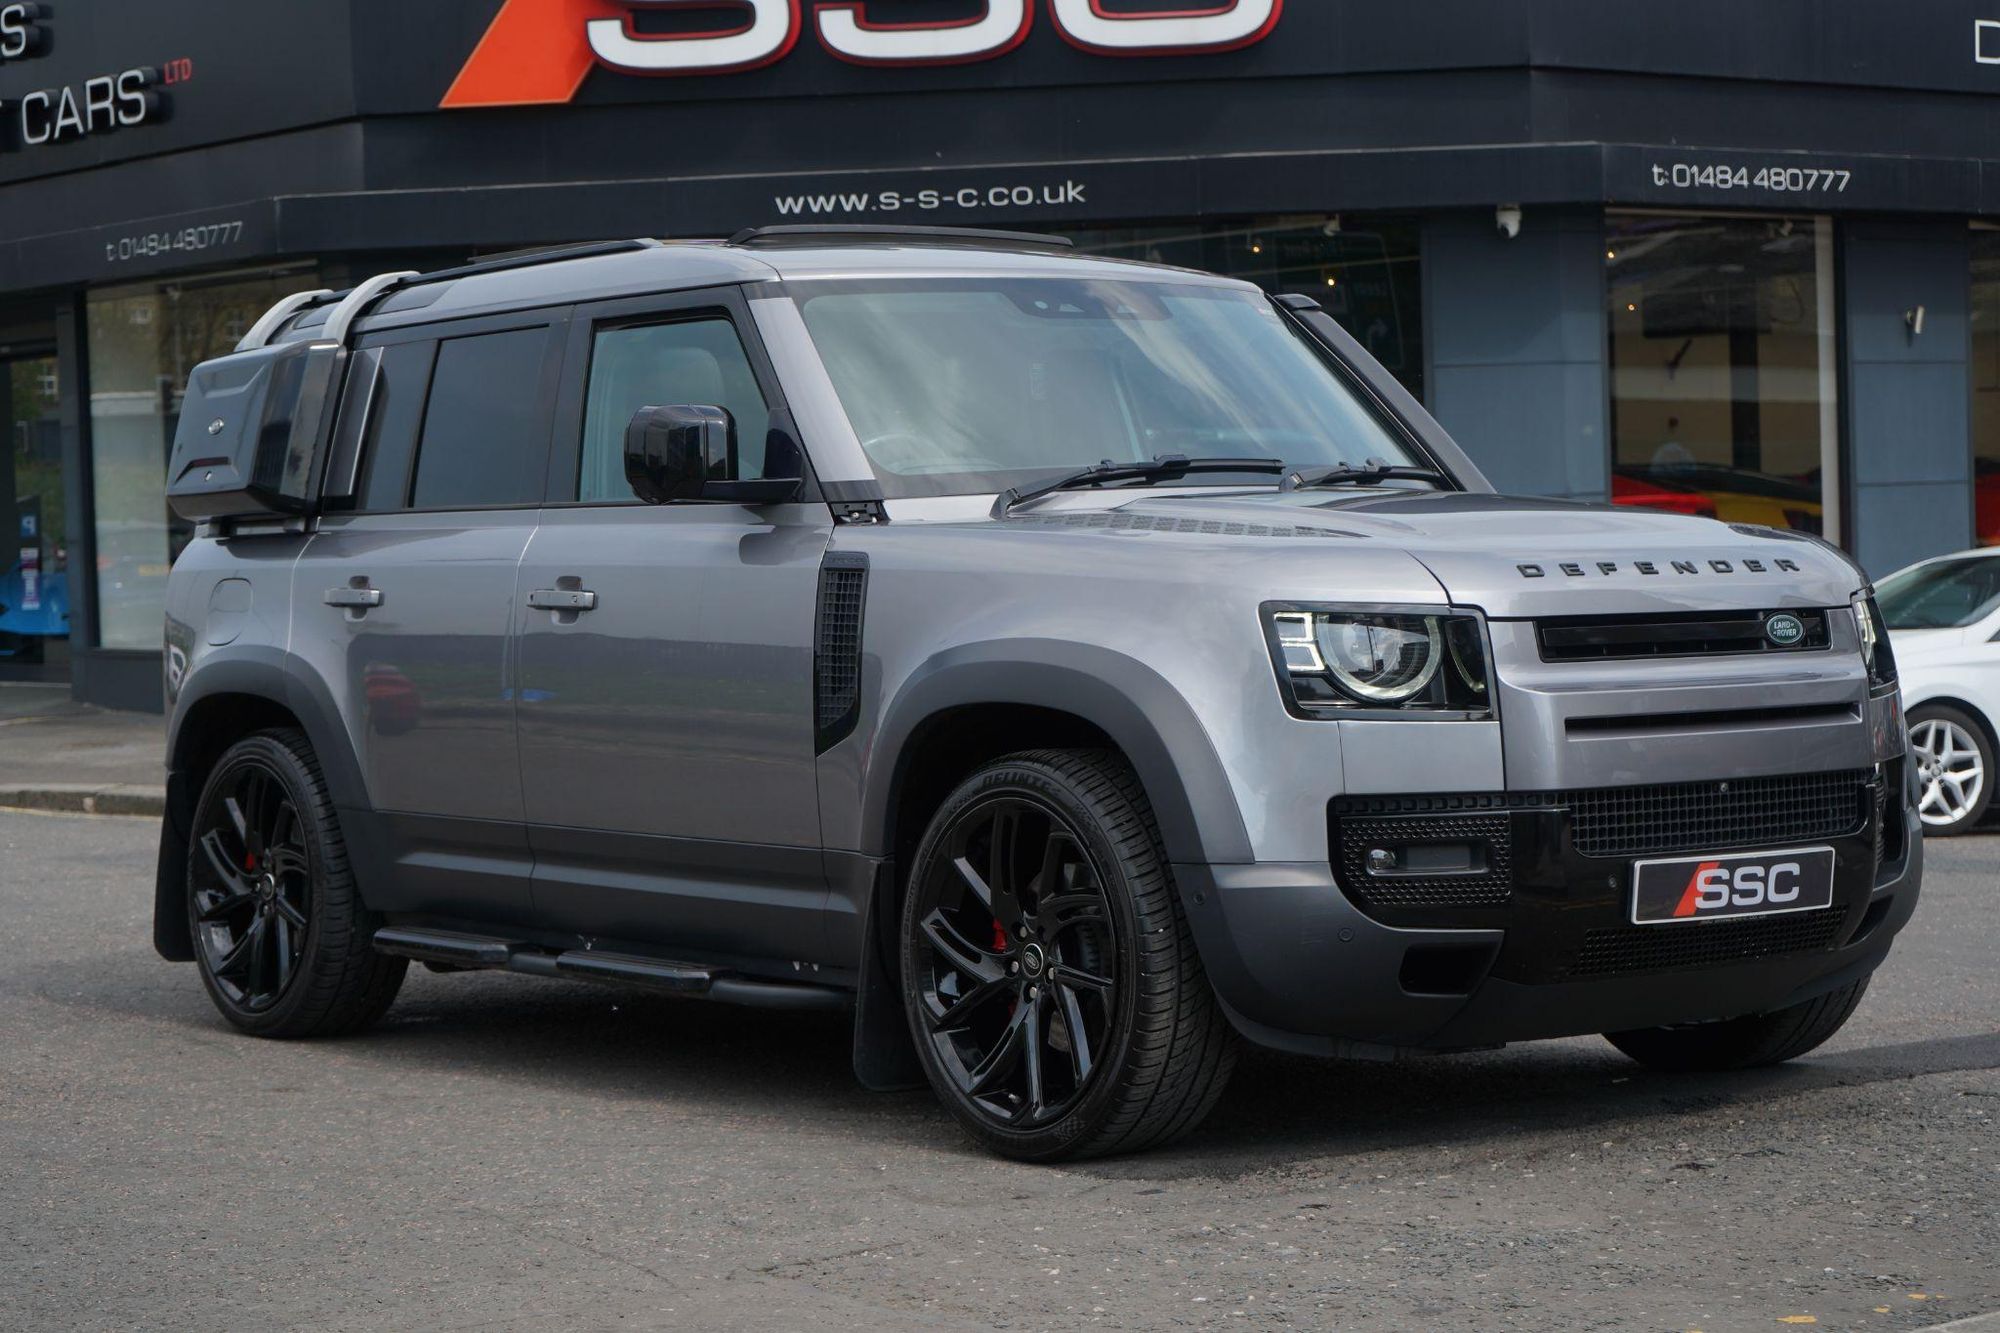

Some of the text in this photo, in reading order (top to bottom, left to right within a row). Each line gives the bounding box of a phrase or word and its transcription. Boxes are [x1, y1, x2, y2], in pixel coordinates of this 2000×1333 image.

[22, 57, 193, 145] CARS LTD
[1752, 167, 1850, 192] 480777
[774, 179, 1086, 215] www.s-s-c.co.uk
[173, 220, 243, 251] 480777
[1516, 558, 1800, 578] DEFENDER
[1773, 620, 1791, 629] LAND
[1776, 628, 1797, 637] ROVER
[1694, 862, 1801, 909] SSC
